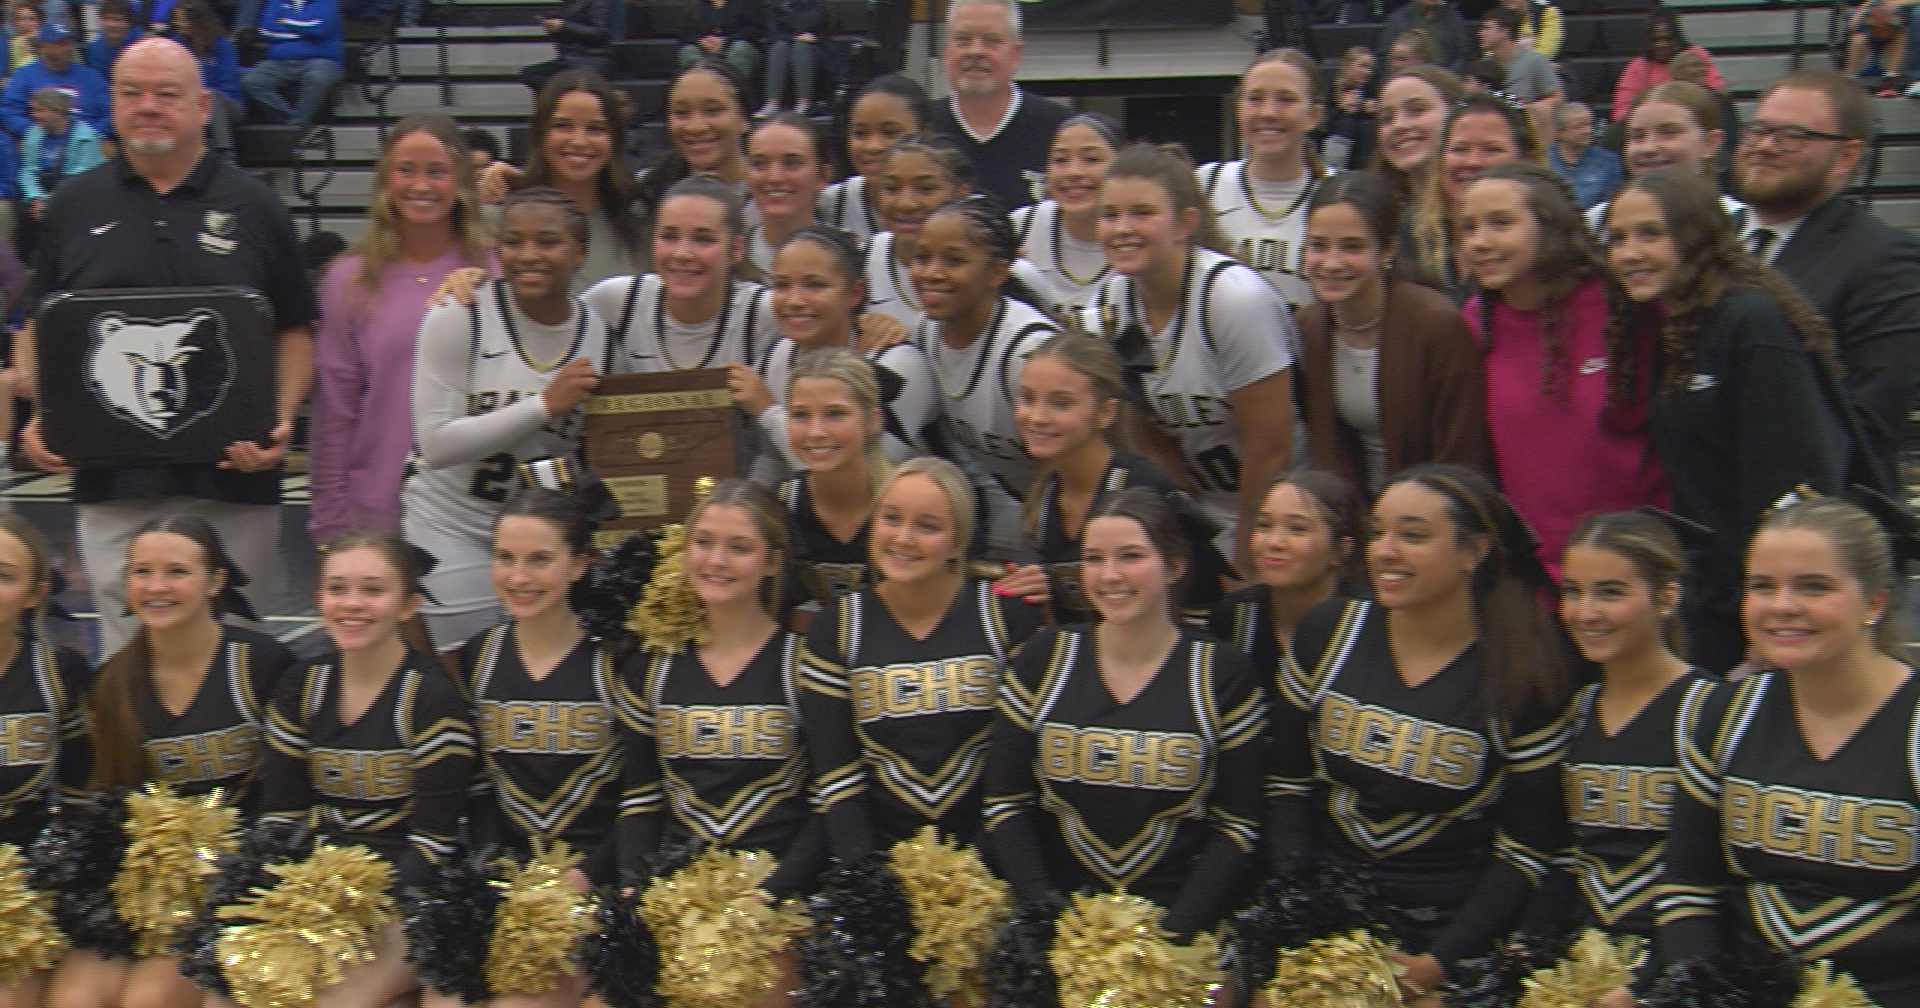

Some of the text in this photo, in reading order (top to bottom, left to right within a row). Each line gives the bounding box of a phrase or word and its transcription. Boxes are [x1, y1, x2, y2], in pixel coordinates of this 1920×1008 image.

[598, 393, 720, 412] REGIONAL
[850, 656, 1001, 724] BCHS
[143, 725, 261, 786] CHS
[655, 706, 796, 761] BCHS
[1038, 722, 1206, 791] BCHS
[1316, 690, 1489, 790] BCHS
[1560, 763, 1676, 831] CHS
[1720, 776, 1919, 872] BCHS
